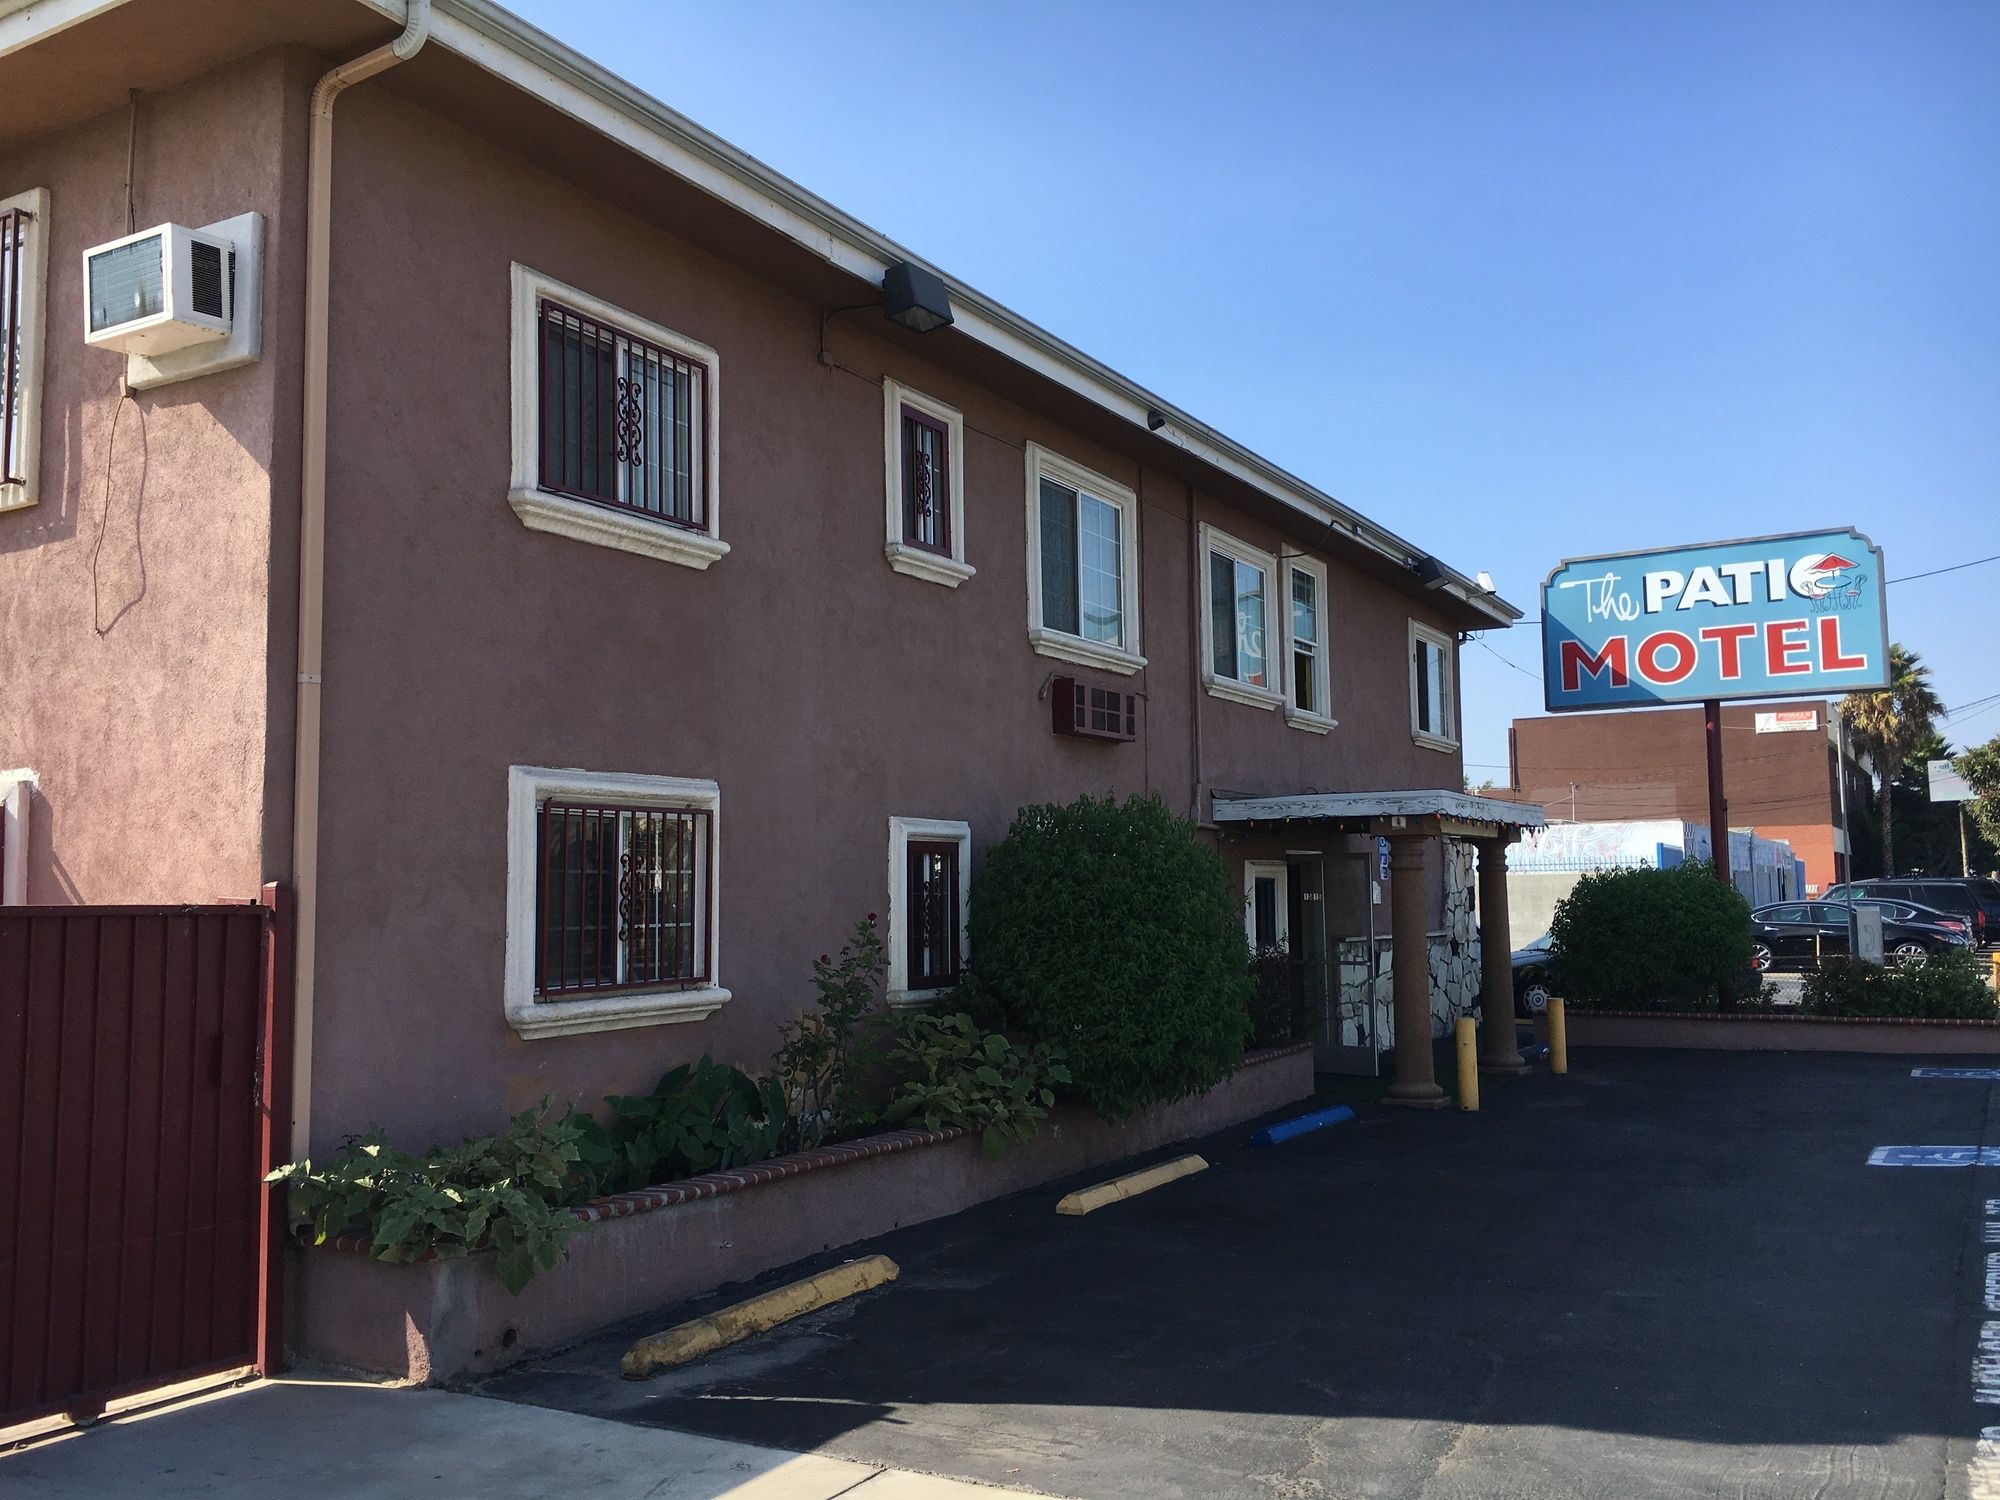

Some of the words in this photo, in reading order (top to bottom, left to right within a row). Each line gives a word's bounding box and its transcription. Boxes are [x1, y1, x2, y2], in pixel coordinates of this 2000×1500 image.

[1559, 572, 1640, 622] The
[1643, 553, 1843, 614] PATIO
[1559, 615, 1867, 692] MOTEL
